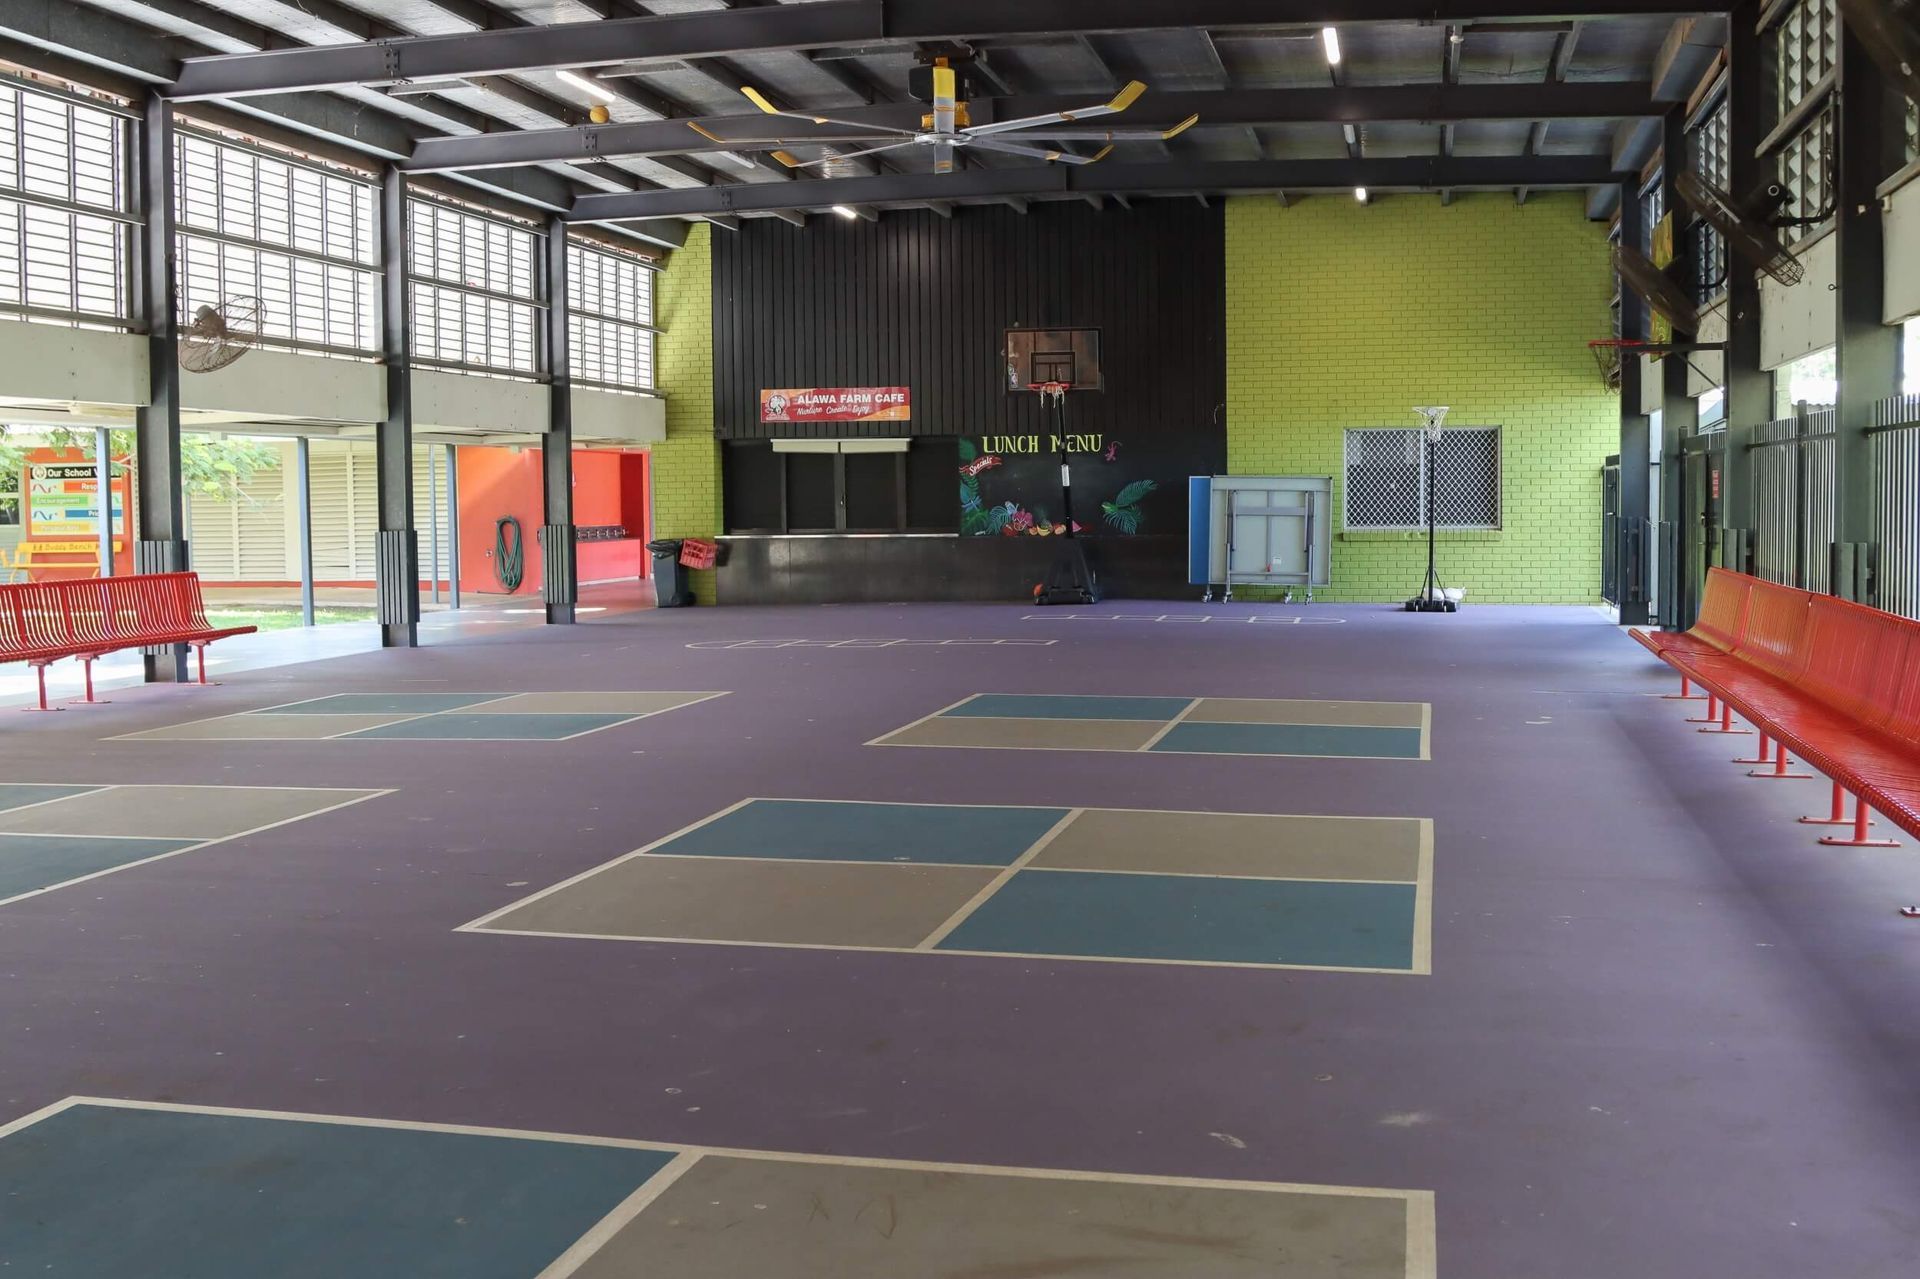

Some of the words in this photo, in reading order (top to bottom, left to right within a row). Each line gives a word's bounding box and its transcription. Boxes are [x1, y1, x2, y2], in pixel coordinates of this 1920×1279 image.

[797, 394, 837, 405] ALAWA
[840, 394, 871, 404] FARM
[875, 393, 905, 403] CAFE
[852, 405, 870, 417] Enjoy
[982, 435, 1039, 453] LUNCH
[969, 456, 993, 476] Specials
[47, 469, 62, 477] Our
[64, 468, 92, 477] School
